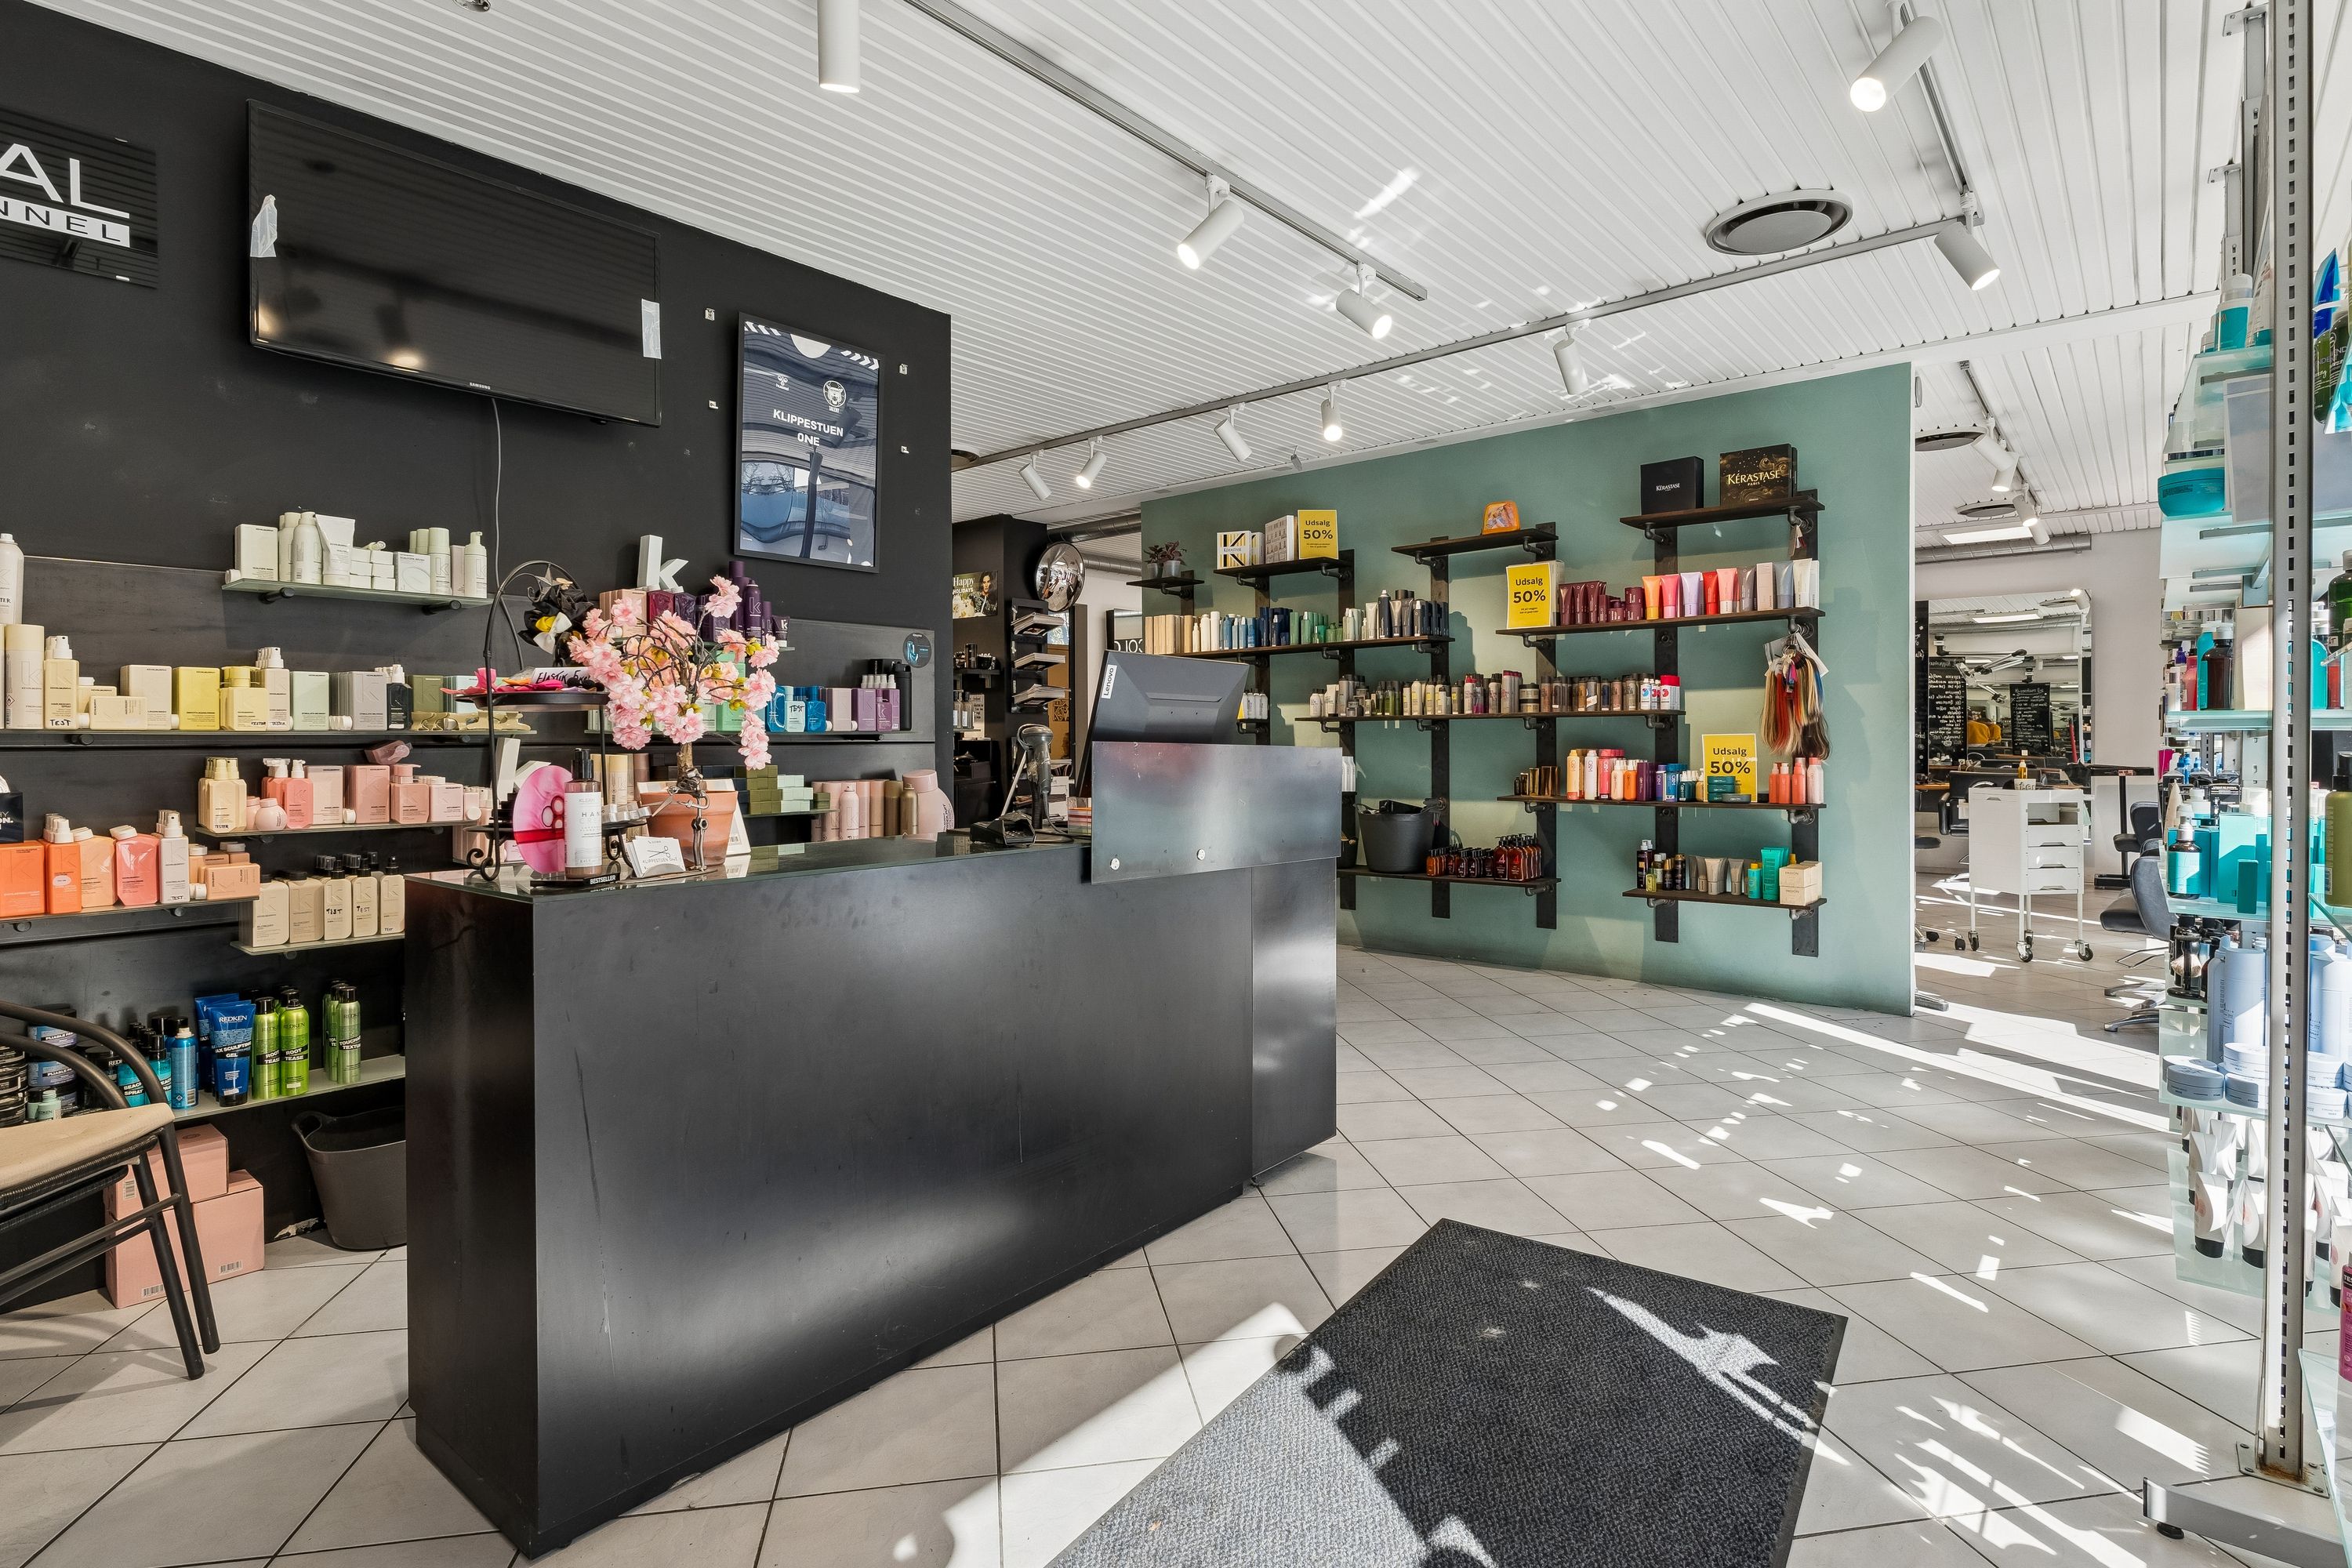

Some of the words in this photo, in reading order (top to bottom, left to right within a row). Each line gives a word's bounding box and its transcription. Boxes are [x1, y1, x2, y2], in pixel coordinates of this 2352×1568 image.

[773, 408, 844, 437] KLIPPESTUEN
[797, 432, 820, 447] ONE
[1727, 470, 1780, 485] KÉRASTASE
[1656, 483, 1680, 492] KÉRASTASE
[1303, 529, 1333, 539] 50%
[953, 577, 975, 587] Happy
[1515, 577, 1543, 586] Udsalg
[1513, 590, 1546, 603] 50%
[1104, 667, 1114, 696] Lenovo
[1713, 747, 1747, 757] Udsalg
[1710, 760, 1751, 775] 50%
[1498, 854, 1505, 863] 4
[590, 875, 615, 884] BESTSELLER
